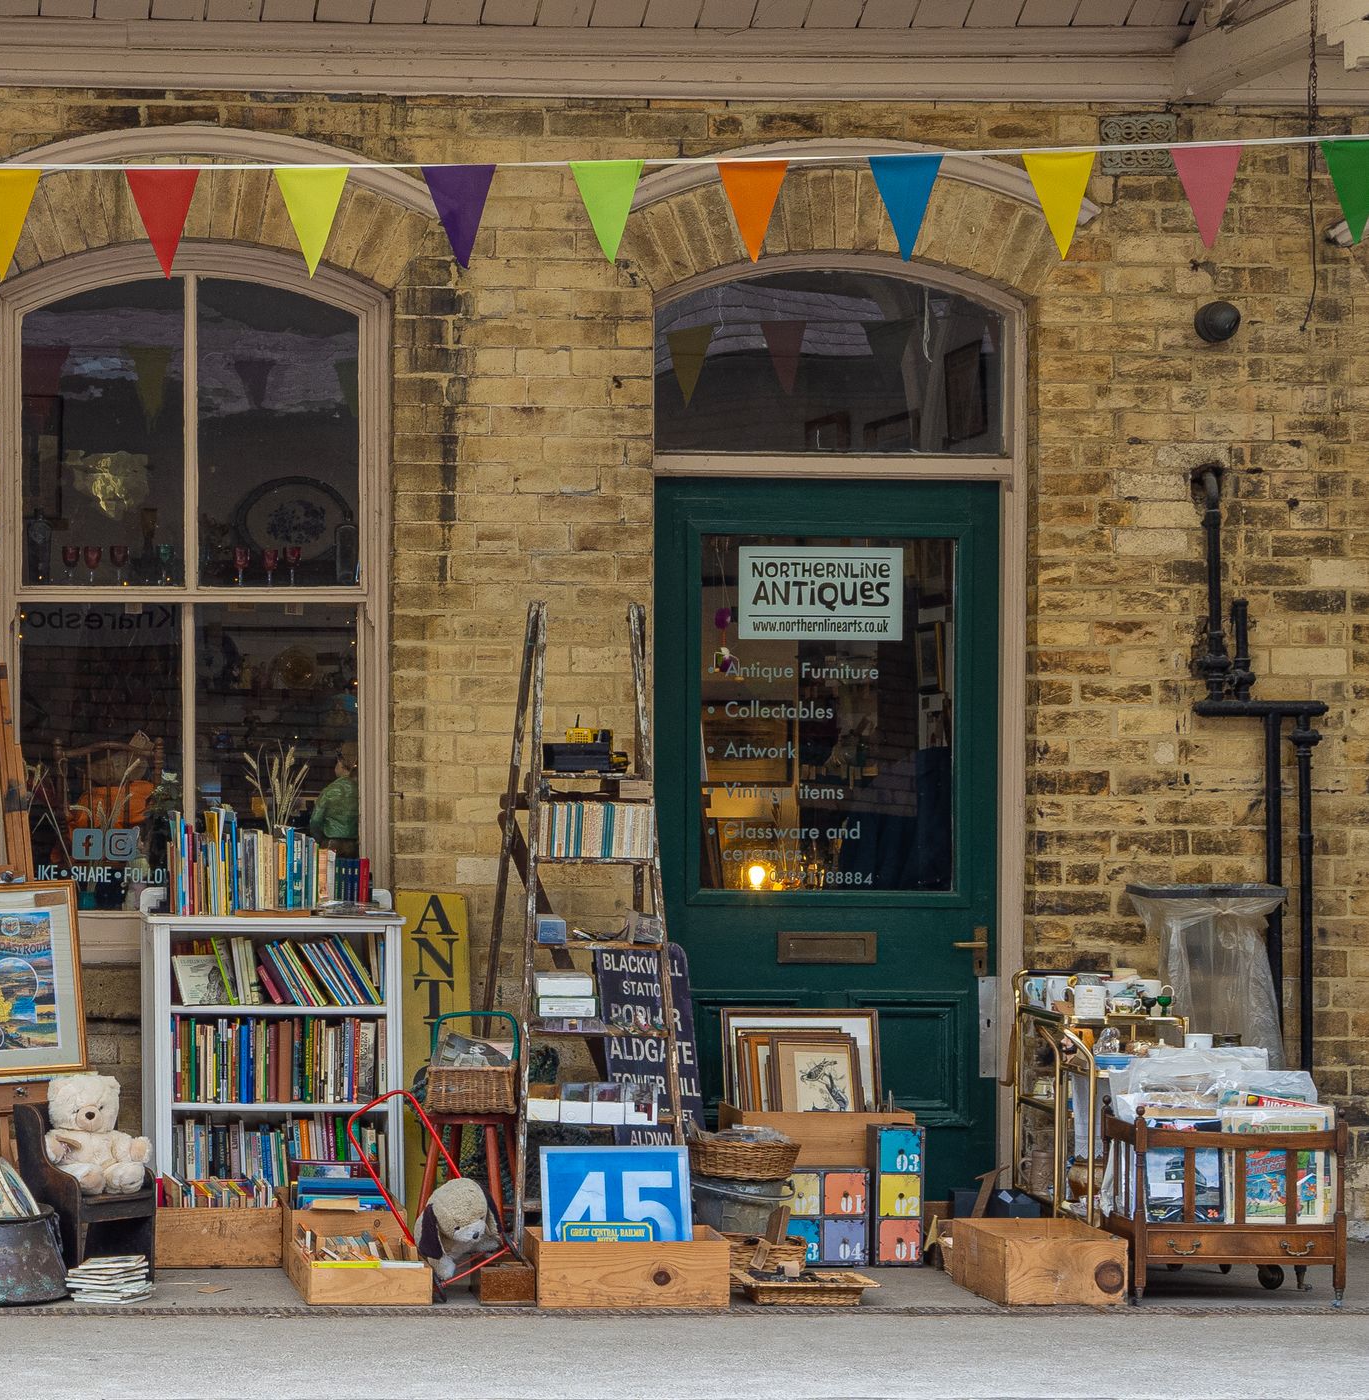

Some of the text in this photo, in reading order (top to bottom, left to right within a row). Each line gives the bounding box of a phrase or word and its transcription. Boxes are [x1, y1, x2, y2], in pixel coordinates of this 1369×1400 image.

[752, 618, 889, 633] www.northernlinearts.co.uk
[725, 662, 879, 682] Antique Furniture
[725, 700, 834, 719] Collectables
[724, 741, 796, 759] Artwork
[723, 782, 845, 804] Vintage items
[723, 820, 861, 840] Glassware and
[722, 849, 804, 862] ceramics
[71, 865, 112, 883] SHARE
[602, 953, 683, 977] BLACKWLL
[622, 981, 661, 998] STATIO
[896, 1153, 920, 1172] 03
[554, 1171, 677, 1242] 45
[795, 1195, 819, 1214] 02
[840, 1194, 866, 1213] 01
[895, 1196, 919, 1216] 02
[570, 1228, 645, 1237] GREAT CENTRAL RAILWAY
[839, 1242, 863, 1260] 04
[895, 1241, 918, 1260] 01
